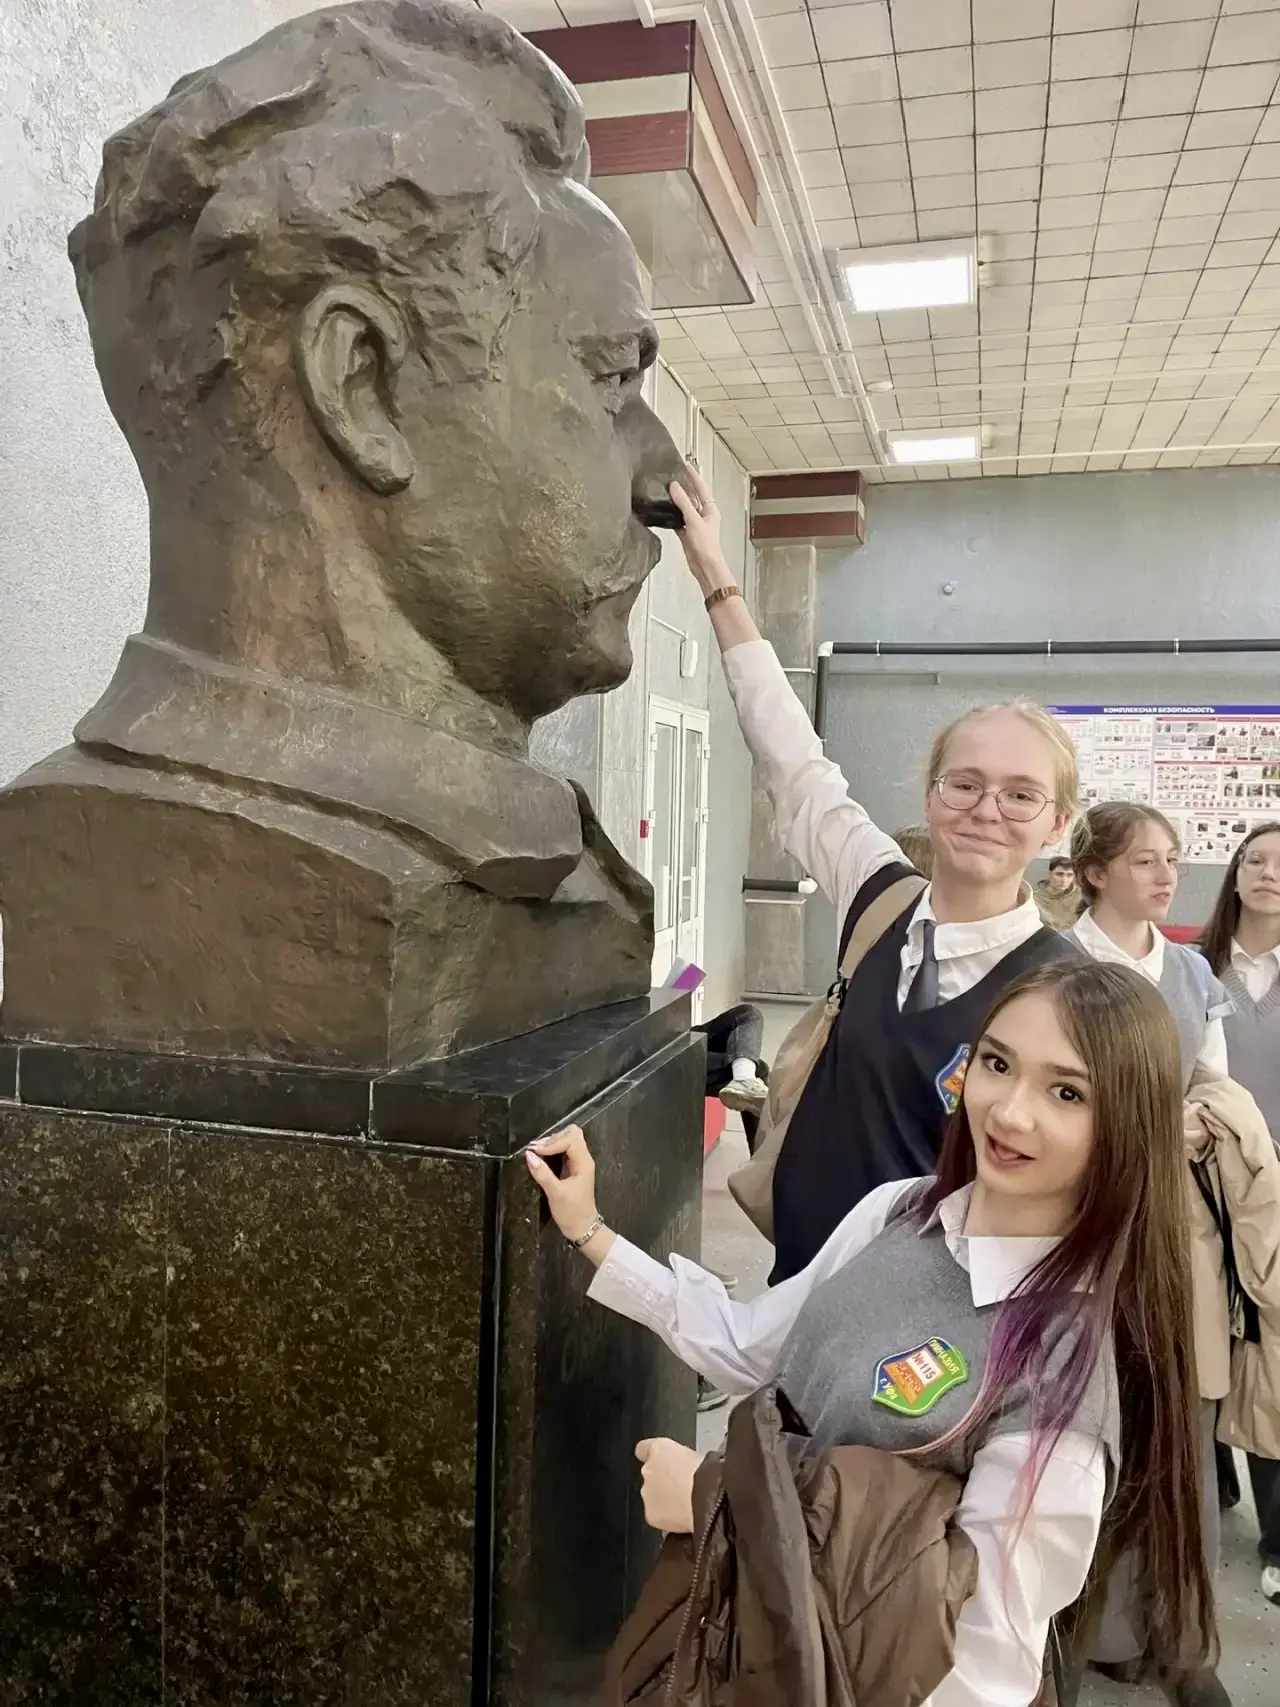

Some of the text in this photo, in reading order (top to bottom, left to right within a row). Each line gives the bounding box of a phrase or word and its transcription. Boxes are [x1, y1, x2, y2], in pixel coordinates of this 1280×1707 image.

[1103, 706, 1215, 714] КОМПЛЕКСНАЯ БЕЗОПАСНОСТЬ
[912, 1353, 936, 1379] №115
[928, 1340, 960, 1375] ГИМНАЗИЯ
